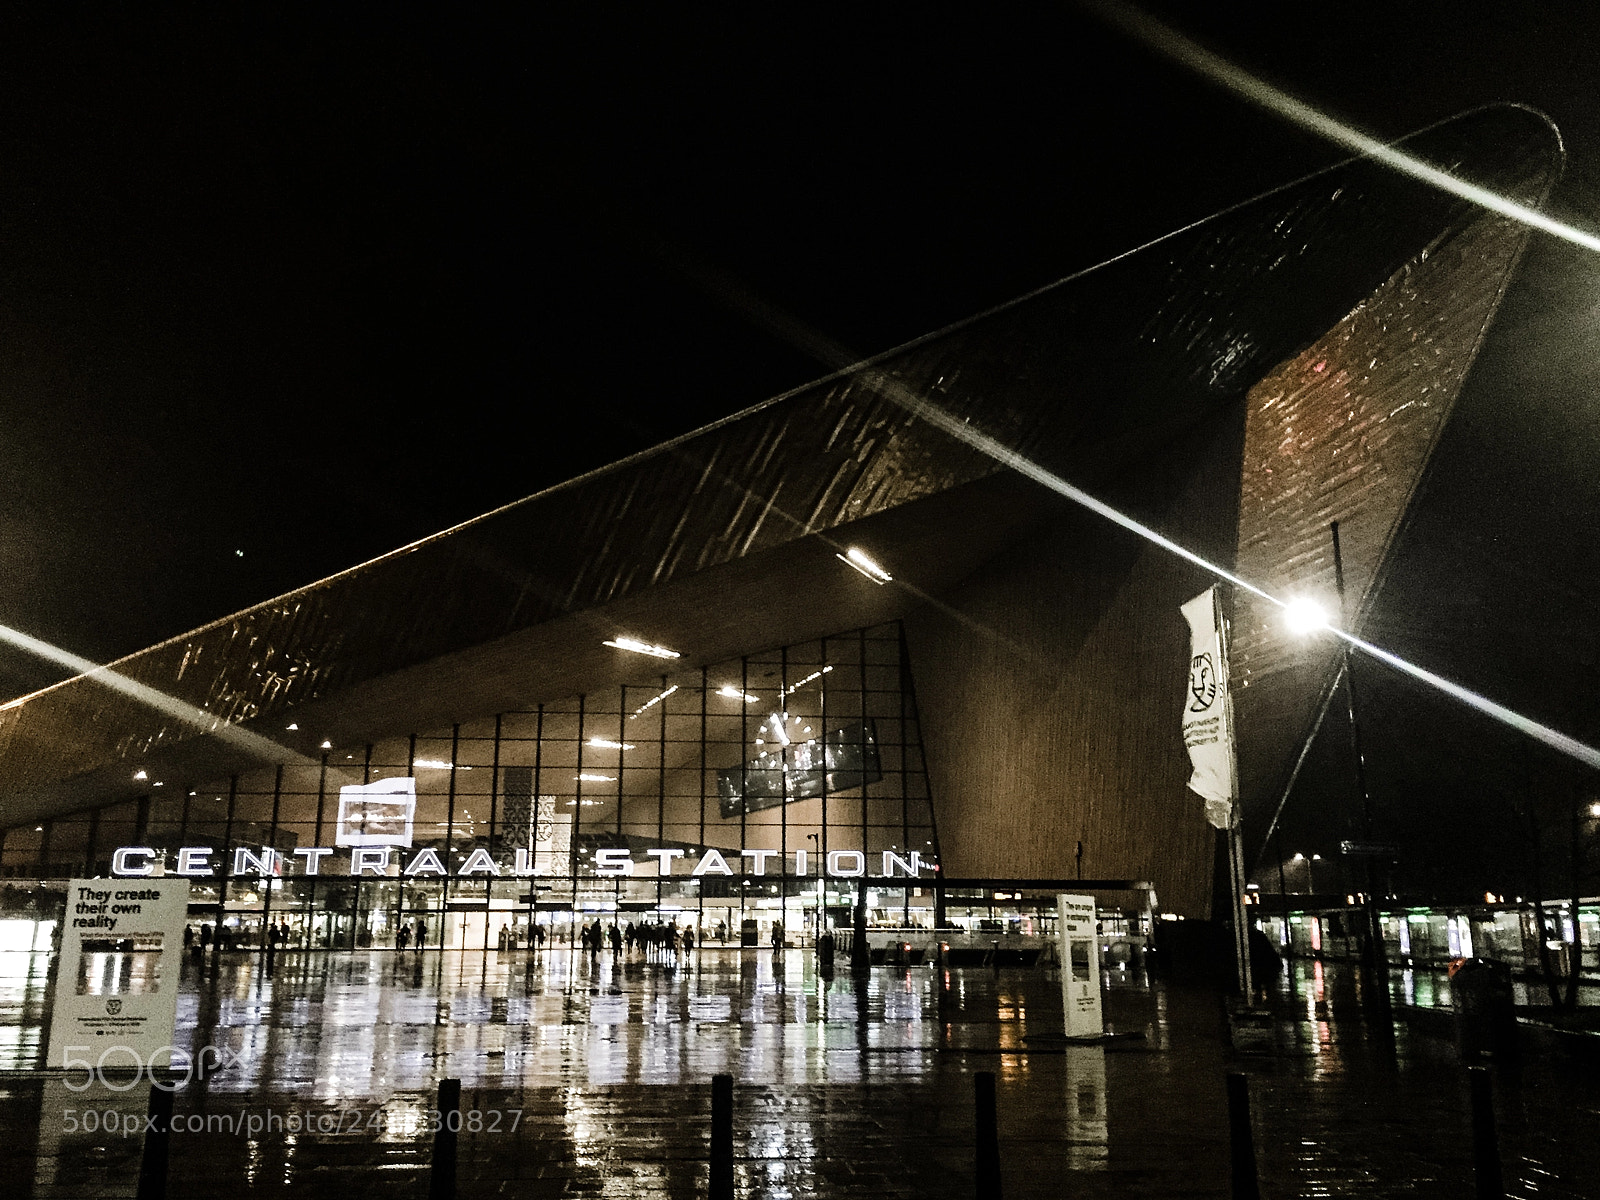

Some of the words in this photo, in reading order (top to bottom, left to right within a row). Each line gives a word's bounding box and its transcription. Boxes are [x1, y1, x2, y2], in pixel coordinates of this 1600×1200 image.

[112, 846, 541, 877] CENTRAAL
[595, 849, 921, 877] STATION
[77, 887, 111, 903] They
[115, 888, 160, 901] create
[75, 902, 108, 914] their
[111, 904, 141, 914] own
[73, 915, 117, 931] reality
